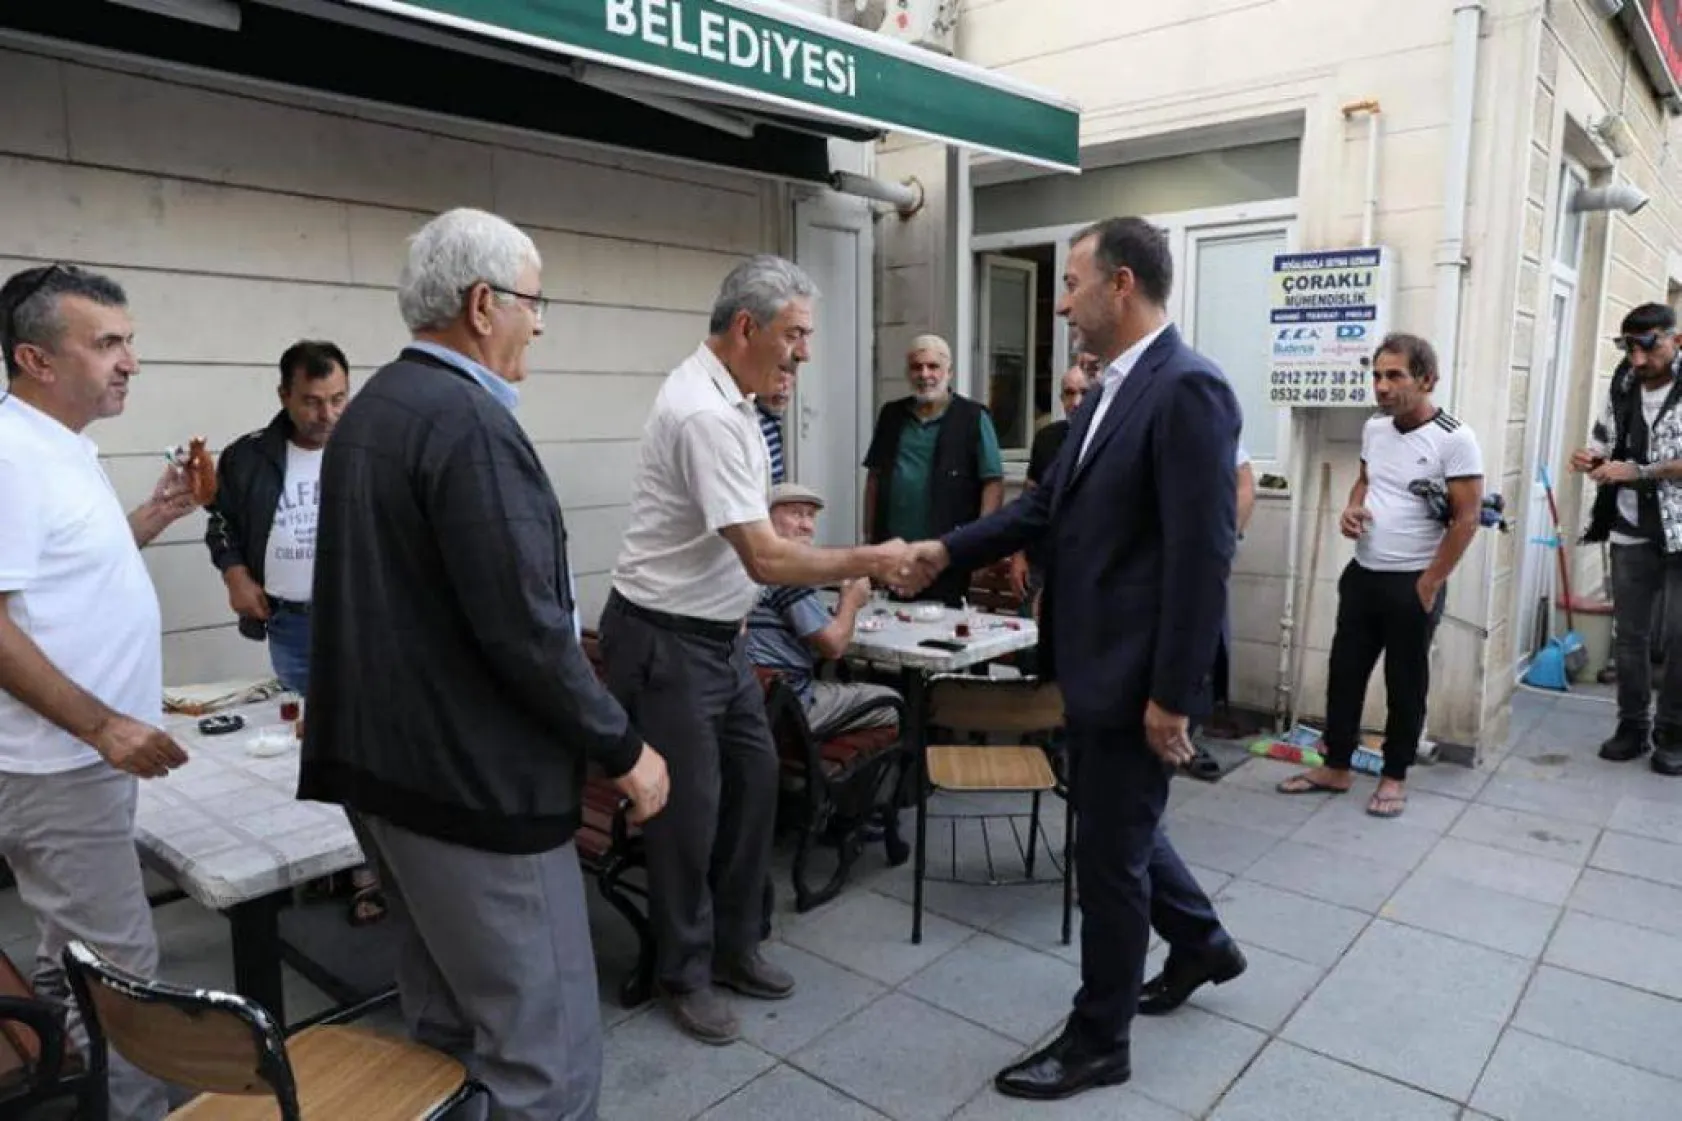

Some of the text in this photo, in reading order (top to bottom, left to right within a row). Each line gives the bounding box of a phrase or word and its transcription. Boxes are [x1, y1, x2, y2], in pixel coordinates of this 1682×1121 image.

[1282, 272, 1372, 294] ÇORAKLI
[1271, 370, 1364, 385] 0212 727 38 21
[1271, 388, 1366, 402] 0532 440 50 49
